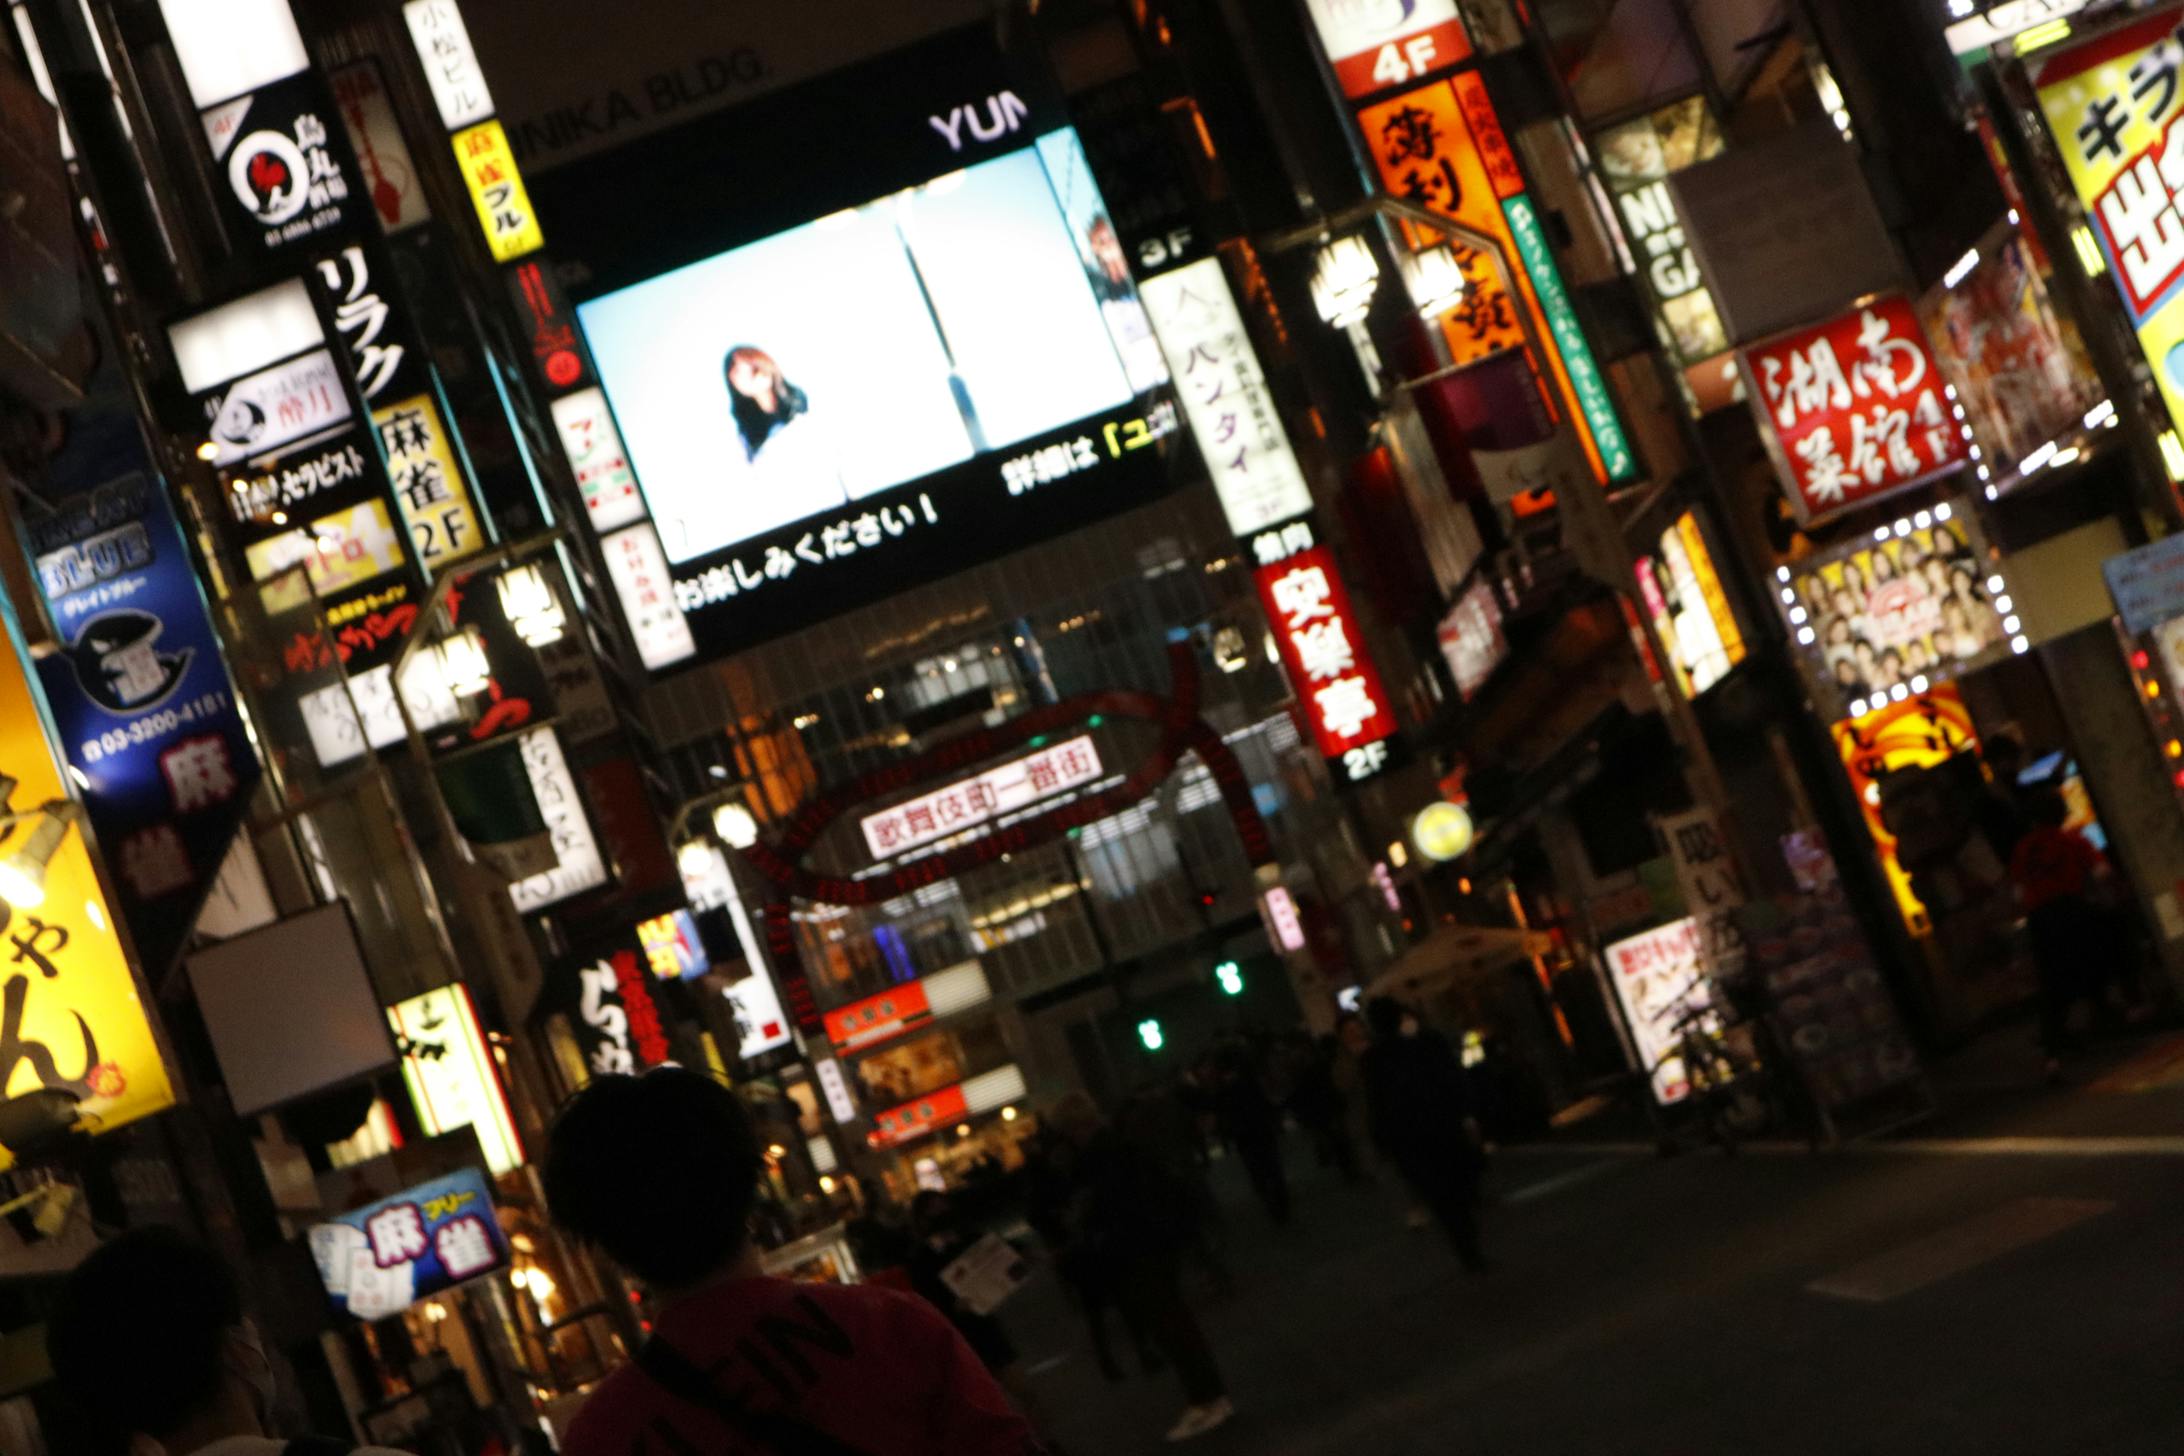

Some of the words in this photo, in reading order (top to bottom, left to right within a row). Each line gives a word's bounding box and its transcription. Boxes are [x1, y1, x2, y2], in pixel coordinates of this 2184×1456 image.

[1373, 35, 1437, 83] 4F
[1138, 227, 1193, 268] 3F
[1761, 310, 1927, 428] 湖南
[373, 409, 452, 511] 麻雀
[411, 508, 467, 558] 2F
[1343, 740, 1387, 781] 2F
[871, 744, 1094, 850] 歌舞伎町一番街
[421, 1190, 476, 1221] フリー
